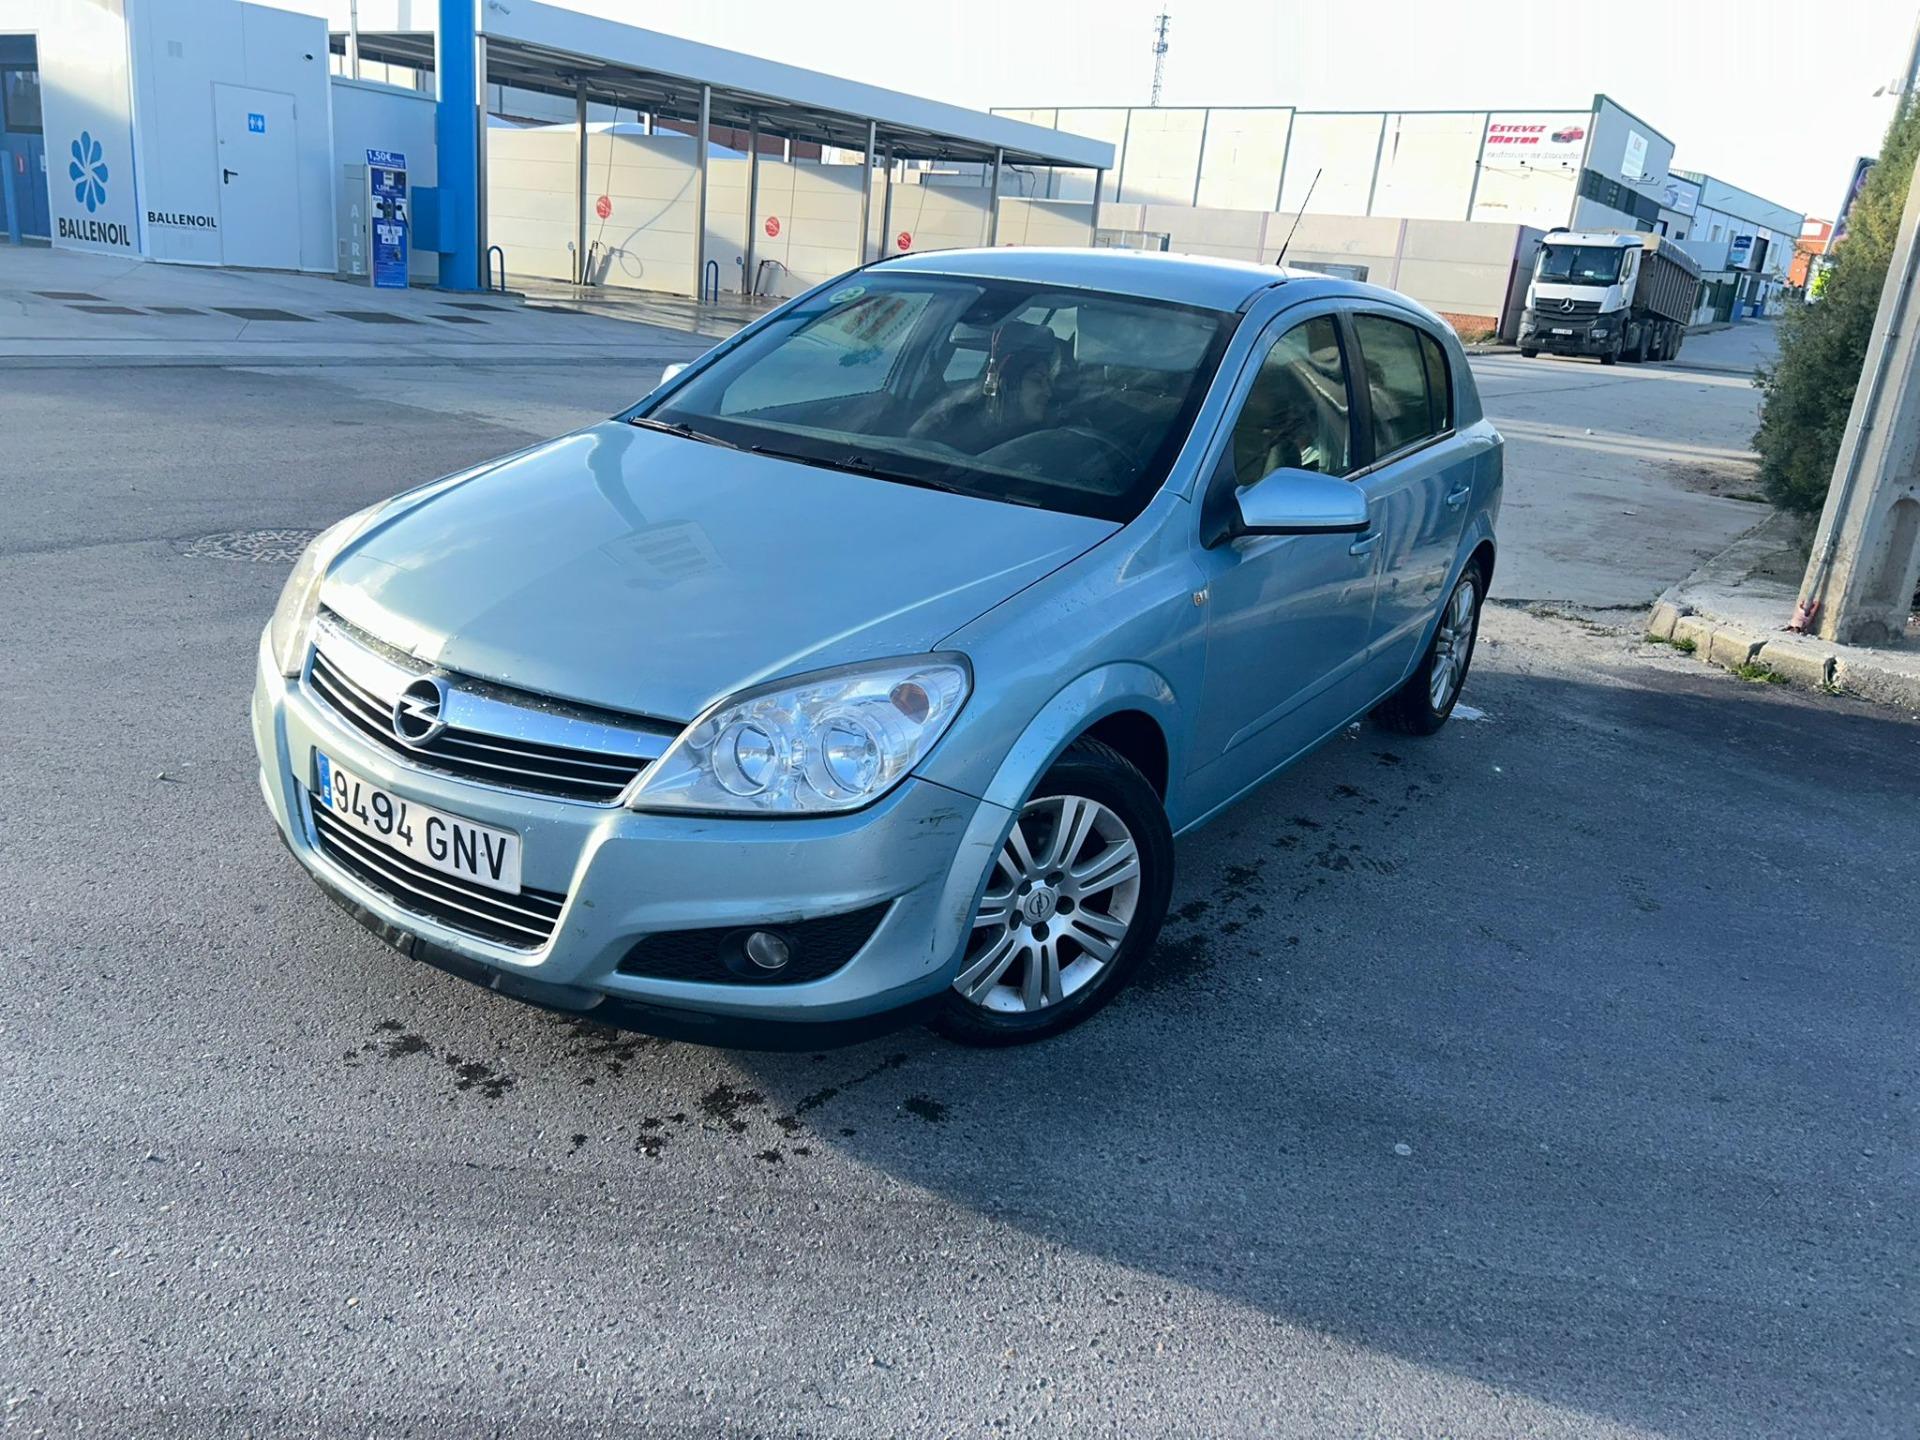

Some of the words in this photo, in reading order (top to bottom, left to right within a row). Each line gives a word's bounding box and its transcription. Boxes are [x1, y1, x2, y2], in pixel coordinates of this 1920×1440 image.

[368, 150, 392, 162] 1,50€
[58, 217, 131, 247] BALLENOIL
[147, 211, 217, 229] BALLENOIL
[350, 203, 361, 274] AIRE
[333, 769, 414, 848] 9494
[425, 815, 507, 881] GNV
